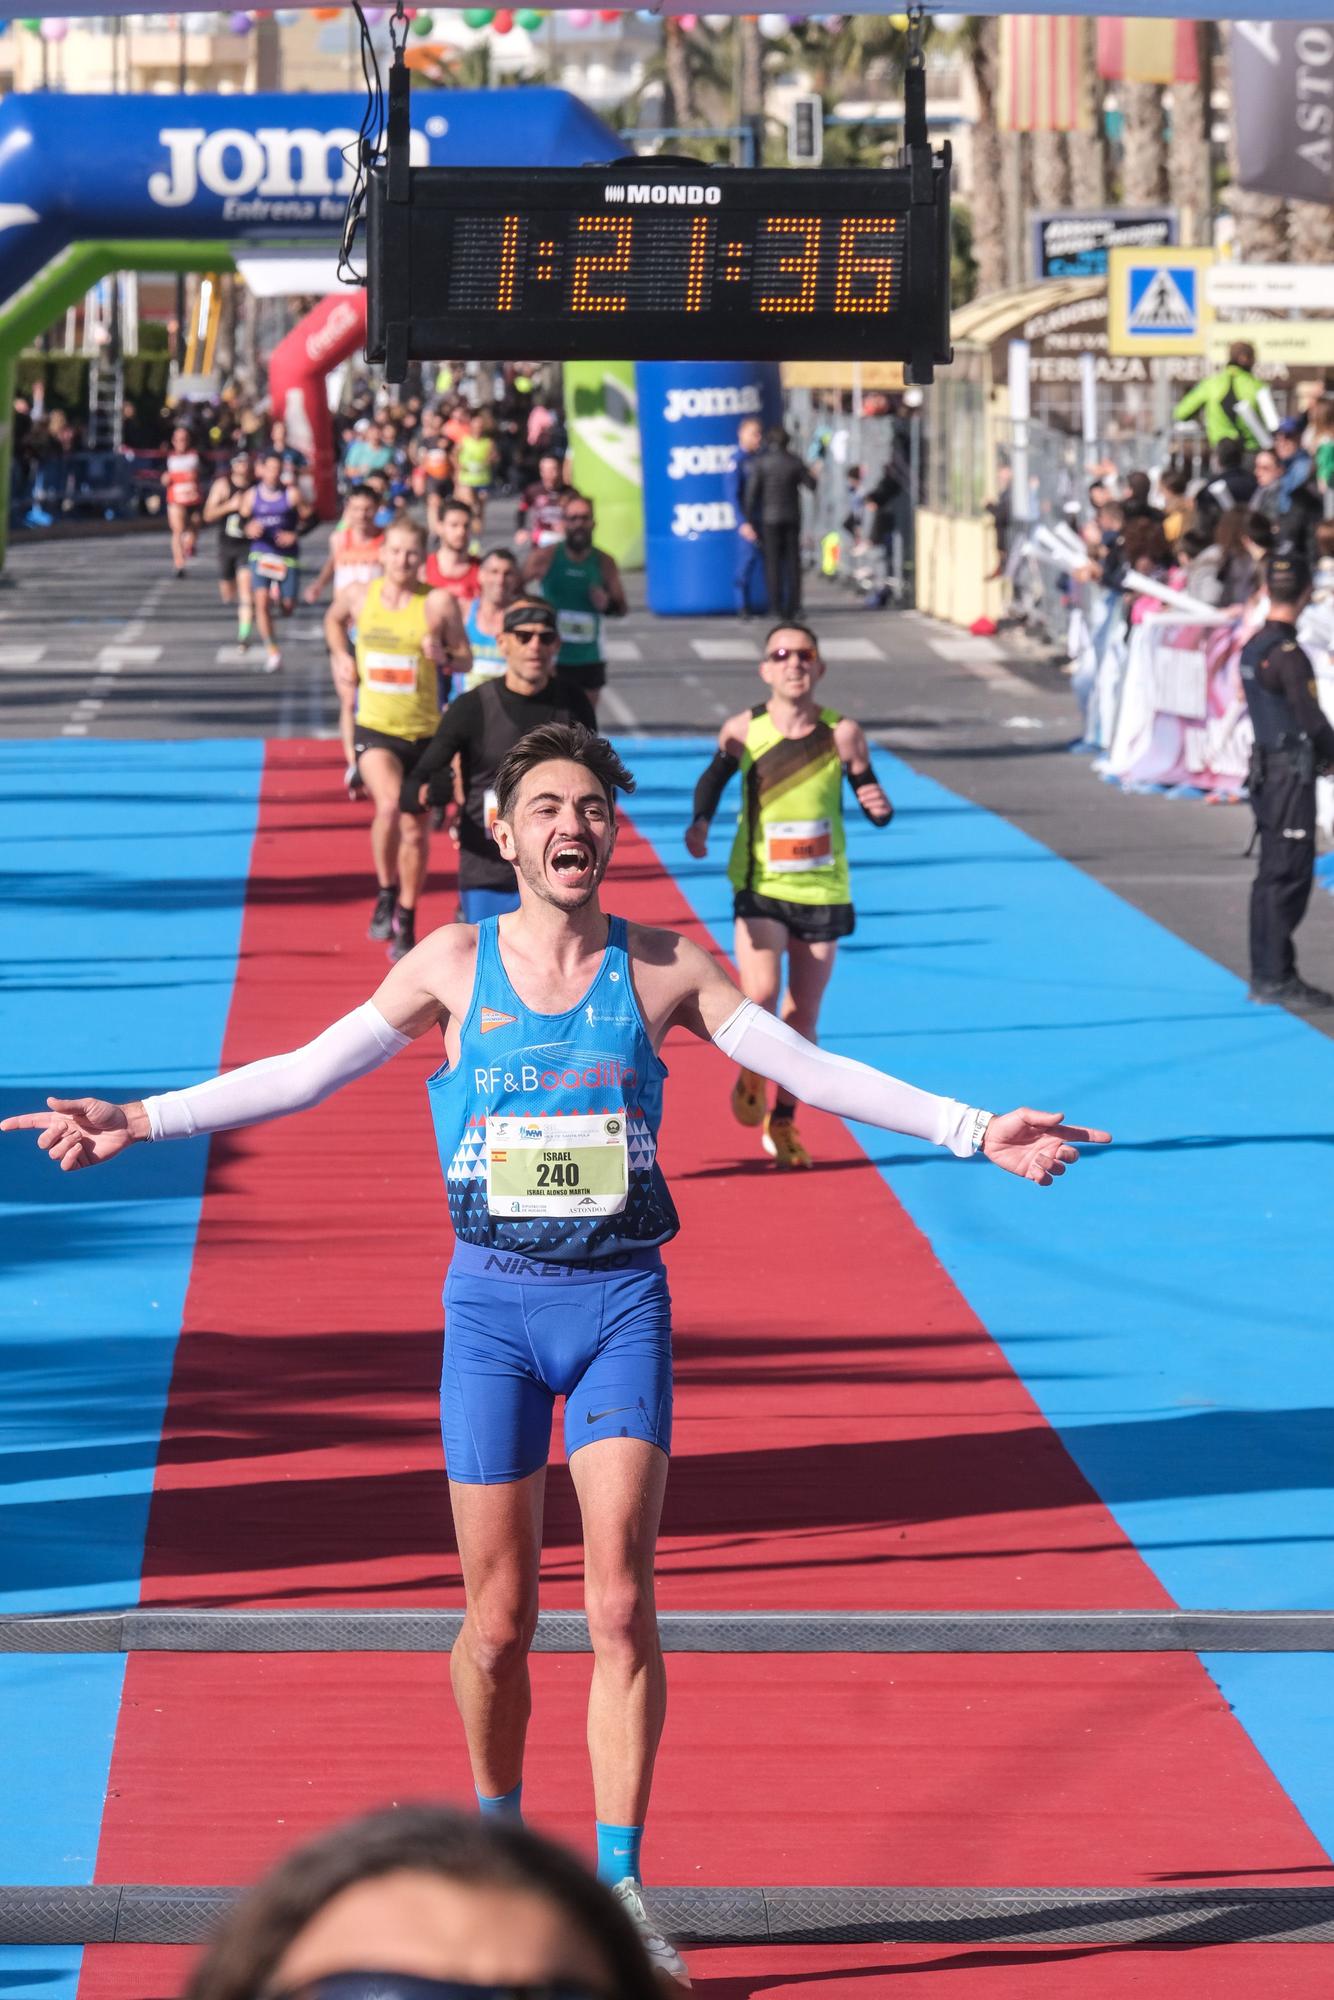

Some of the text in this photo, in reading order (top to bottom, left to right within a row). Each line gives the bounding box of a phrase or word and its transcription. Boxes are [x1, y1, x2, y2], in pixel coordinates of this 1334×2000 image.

[627, 185, 721, 204] MONDO
[498, 216, 897, 313] 1:21:36
[663, 385, 763, 422] Joma
[668, 445, 737, 480] Jom
[474, 1061, 638, 1094] RF&Boadilla
[543, 1152, 572, 1161] ISRAEL
[536, 1163, 580, 1187] 240
[484, 1254, 559, 1277] NIKE
